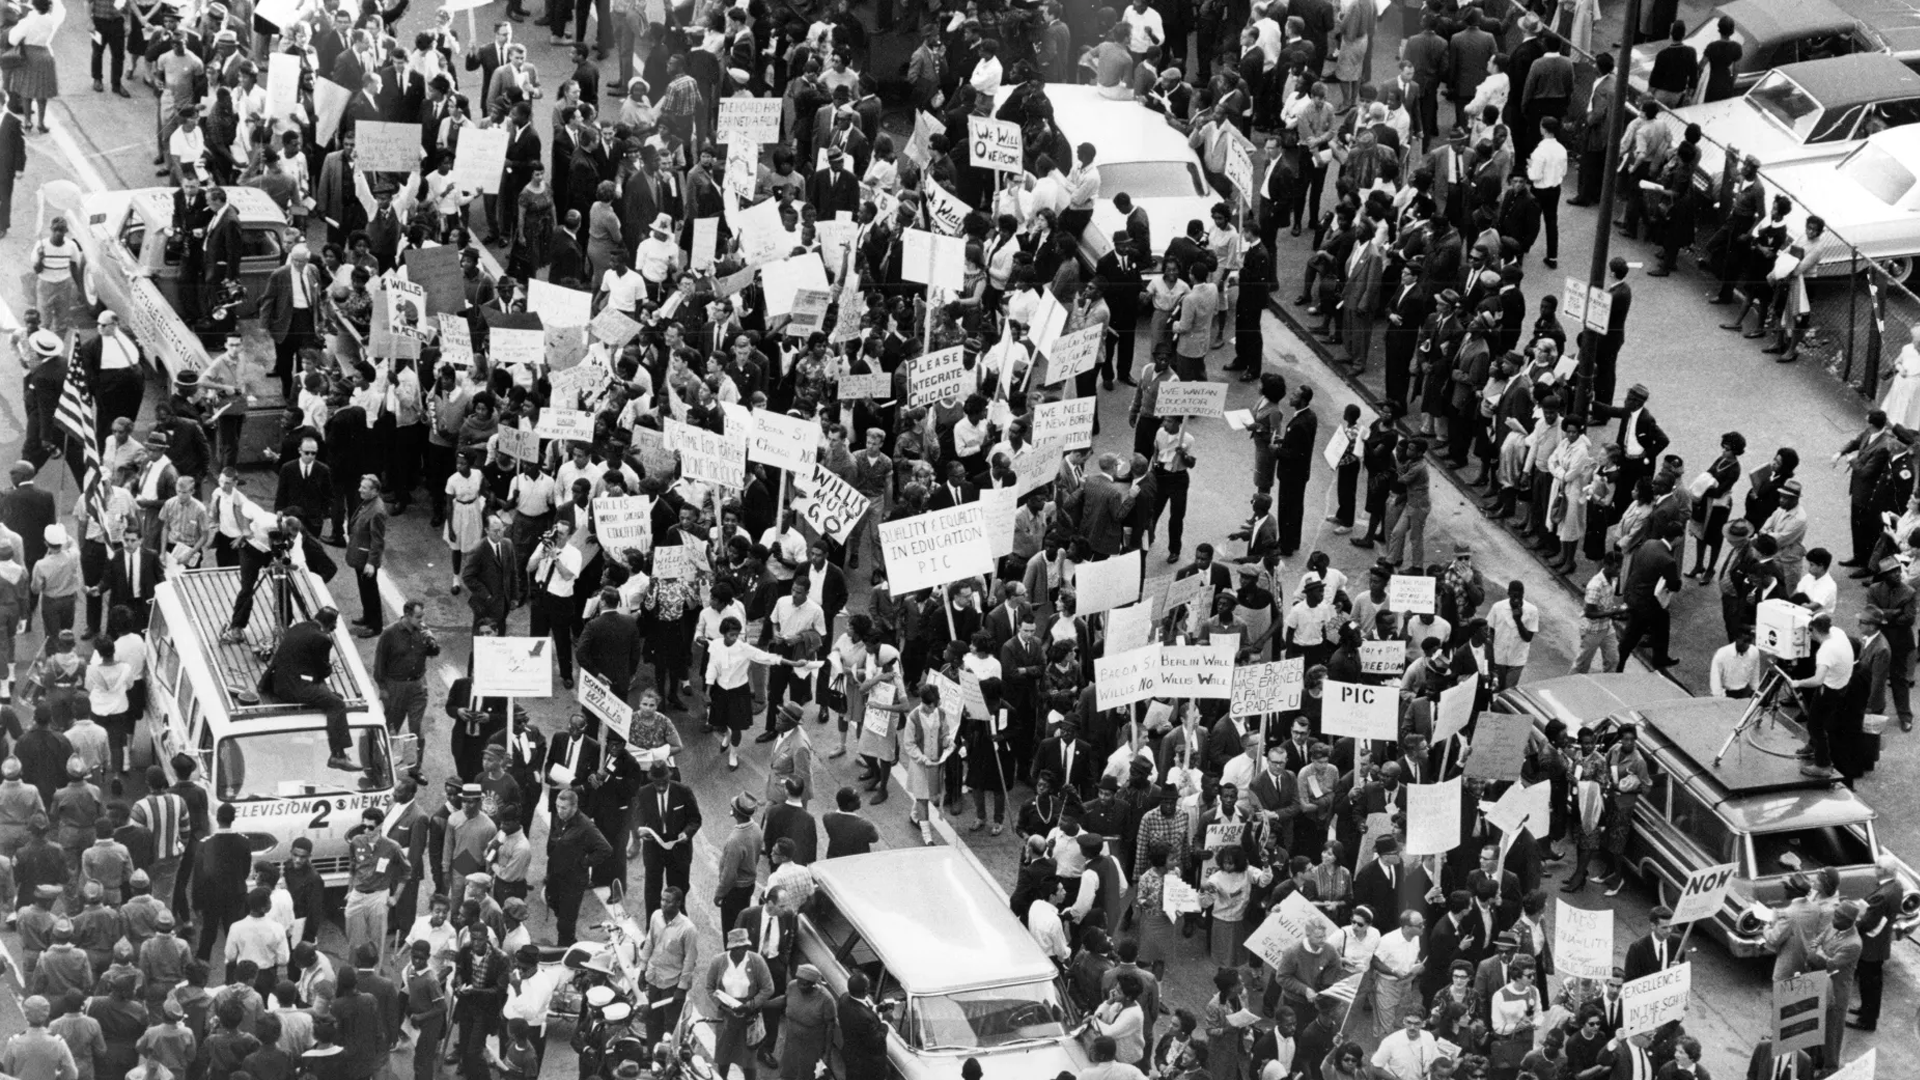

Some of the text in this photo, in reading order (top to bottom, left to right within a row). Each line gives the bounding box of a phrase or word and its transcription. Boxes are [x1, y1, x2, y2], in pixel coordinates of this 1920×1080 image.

[389, 278, 421, 296] WILLIS
[392, 325, 427, 341] IN ACTION
[908, 352, 958, 377] PLEASE
[908, 368, 962, 394] INTEGRATE
[1161, 387, 1179, 396] WE
[909, 383, 960, 409] CHICAGO
[1041, 401, 1089, 418] WE NEED
[1046, 417, 1067, 429] NEW
[1069, 413, 1094, 427] BOARD
[800, 448, 815, 465] NO
[812, 465, 867, 517] WILLIS
[813, 489, 854, 525] MUST
[808, 503, 841, 534] GO
[881, 521, 926, 544] QUALITY
[931, 519, 938, 531] &
[939, 506, 984, 530] EQUALITY
[891, 527, 982, 560] IN EDUCATION
[1161, 654, 1200, 667] BERLIN
[1235, 659, 1303, 678] THE BOARD
[1100, 665, 1138, 682] BACON
[1234, 671, 1302, 690] HAS EARNED
[1099, 677, 1153, 701] WILLIS NO
[1233, 686, 1281, 701] A FAILING
[1342, 686, 1375, 705] PIC
[1232, 698, 1275, 715] GRADE
[1288, 694, 1299, 708] U
[235, 795, 390, 829] ELEVISION 2 NEWS
[1207, 826, 1243, 836] MAYOR
[1686, 869, 1733, 896] NOW
[1624, 970, 1681, 999] EXCELLENCE
[1630, 1006, 1640, 1022] IN
[1643, 1001, 1660, 1017] THE
